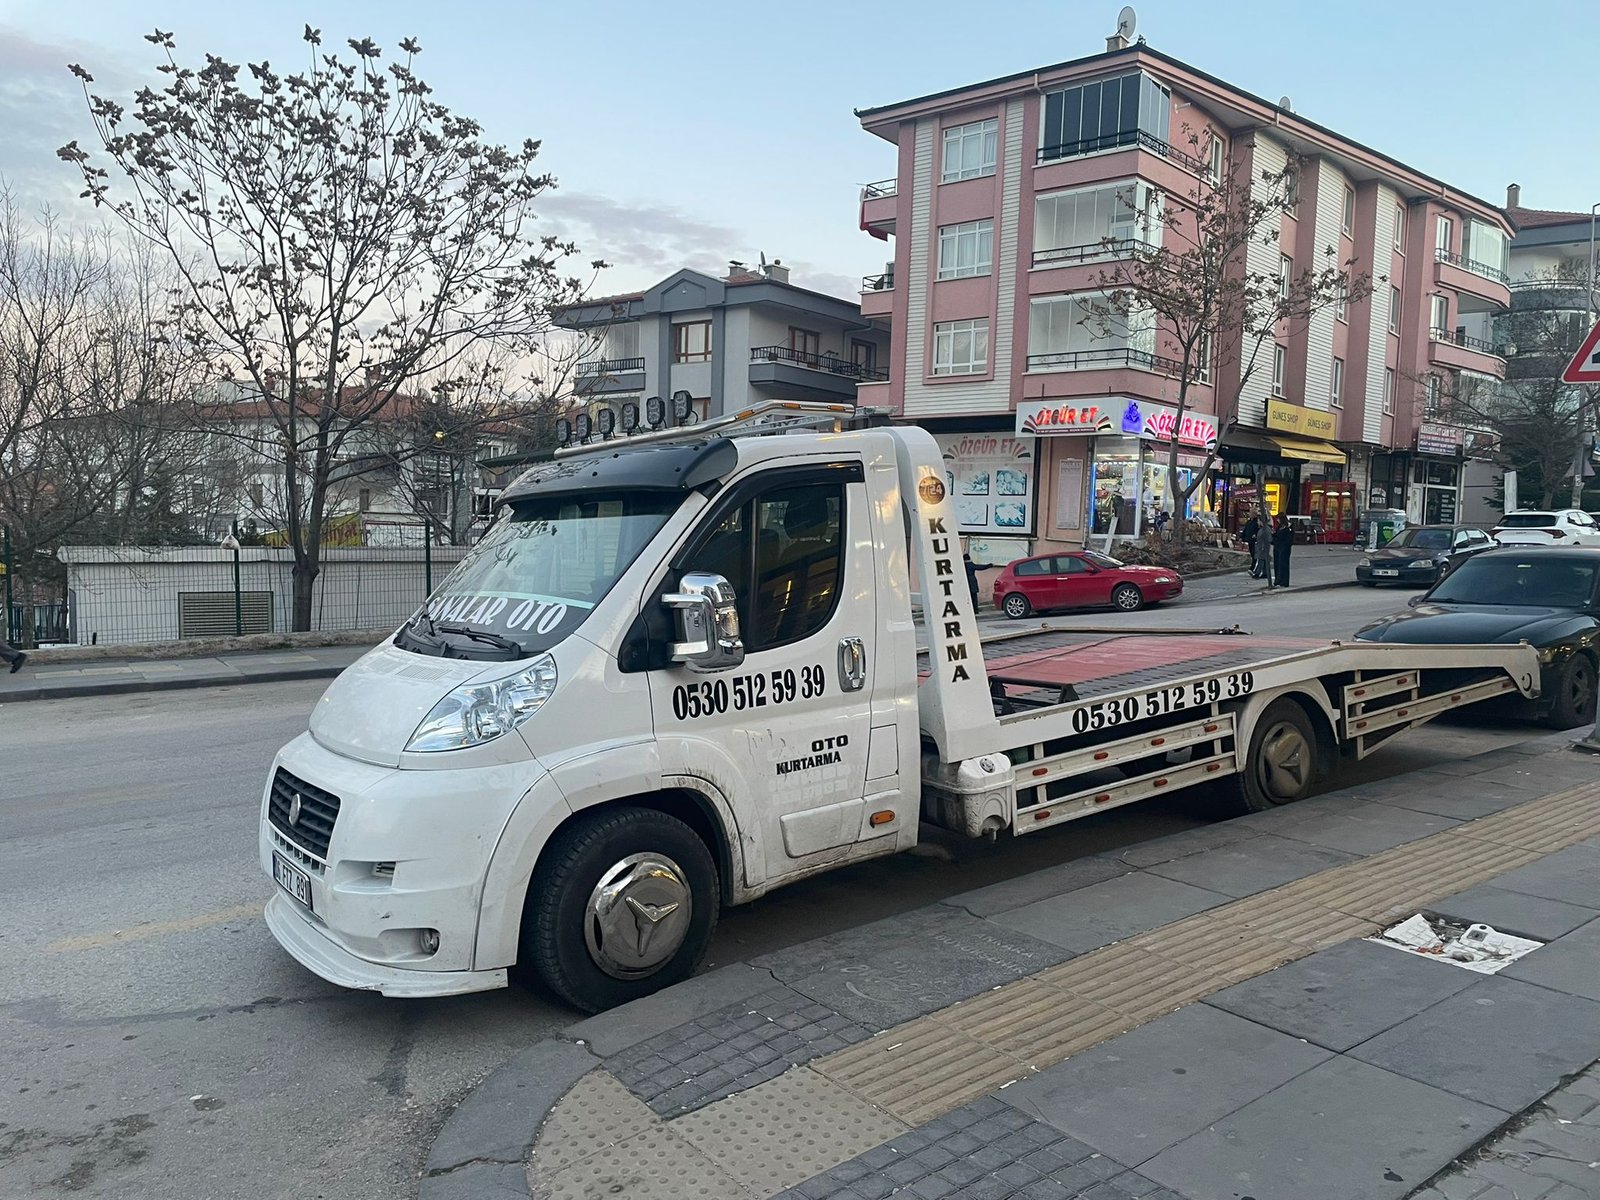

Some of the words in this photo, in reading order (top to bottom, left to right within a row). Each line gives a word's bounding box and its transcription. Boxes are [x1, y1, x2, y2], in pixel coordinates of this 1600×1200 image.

[1036, 406, 1077, 425] ÖZGÜR
[1080, 406, 1098, 423] ET
[1194, 419, 1207, 439] ET
[960, 436, 997, 455] ÖZGÜR
[1000, 438, 1015, 454] ET
[928, 518, 970, 683] KURTARMA
[506, 598, 568, 635] OTO
[673, 679, 729, 720] 0530
[732, 673, 767, 710] 512
[771, 668, 797, 703] 59
[801, 664, 825, 698] 39
[1072, 697, 1139, 733] 0530
[1146, 686, 1185, 716] 512
[1193, 678, 1221, 705] 59
[1227, 671, 1254, 697] 39
[811, 735, 849, 752] OTO
[776, 751, 842, 775] KURTARMA
